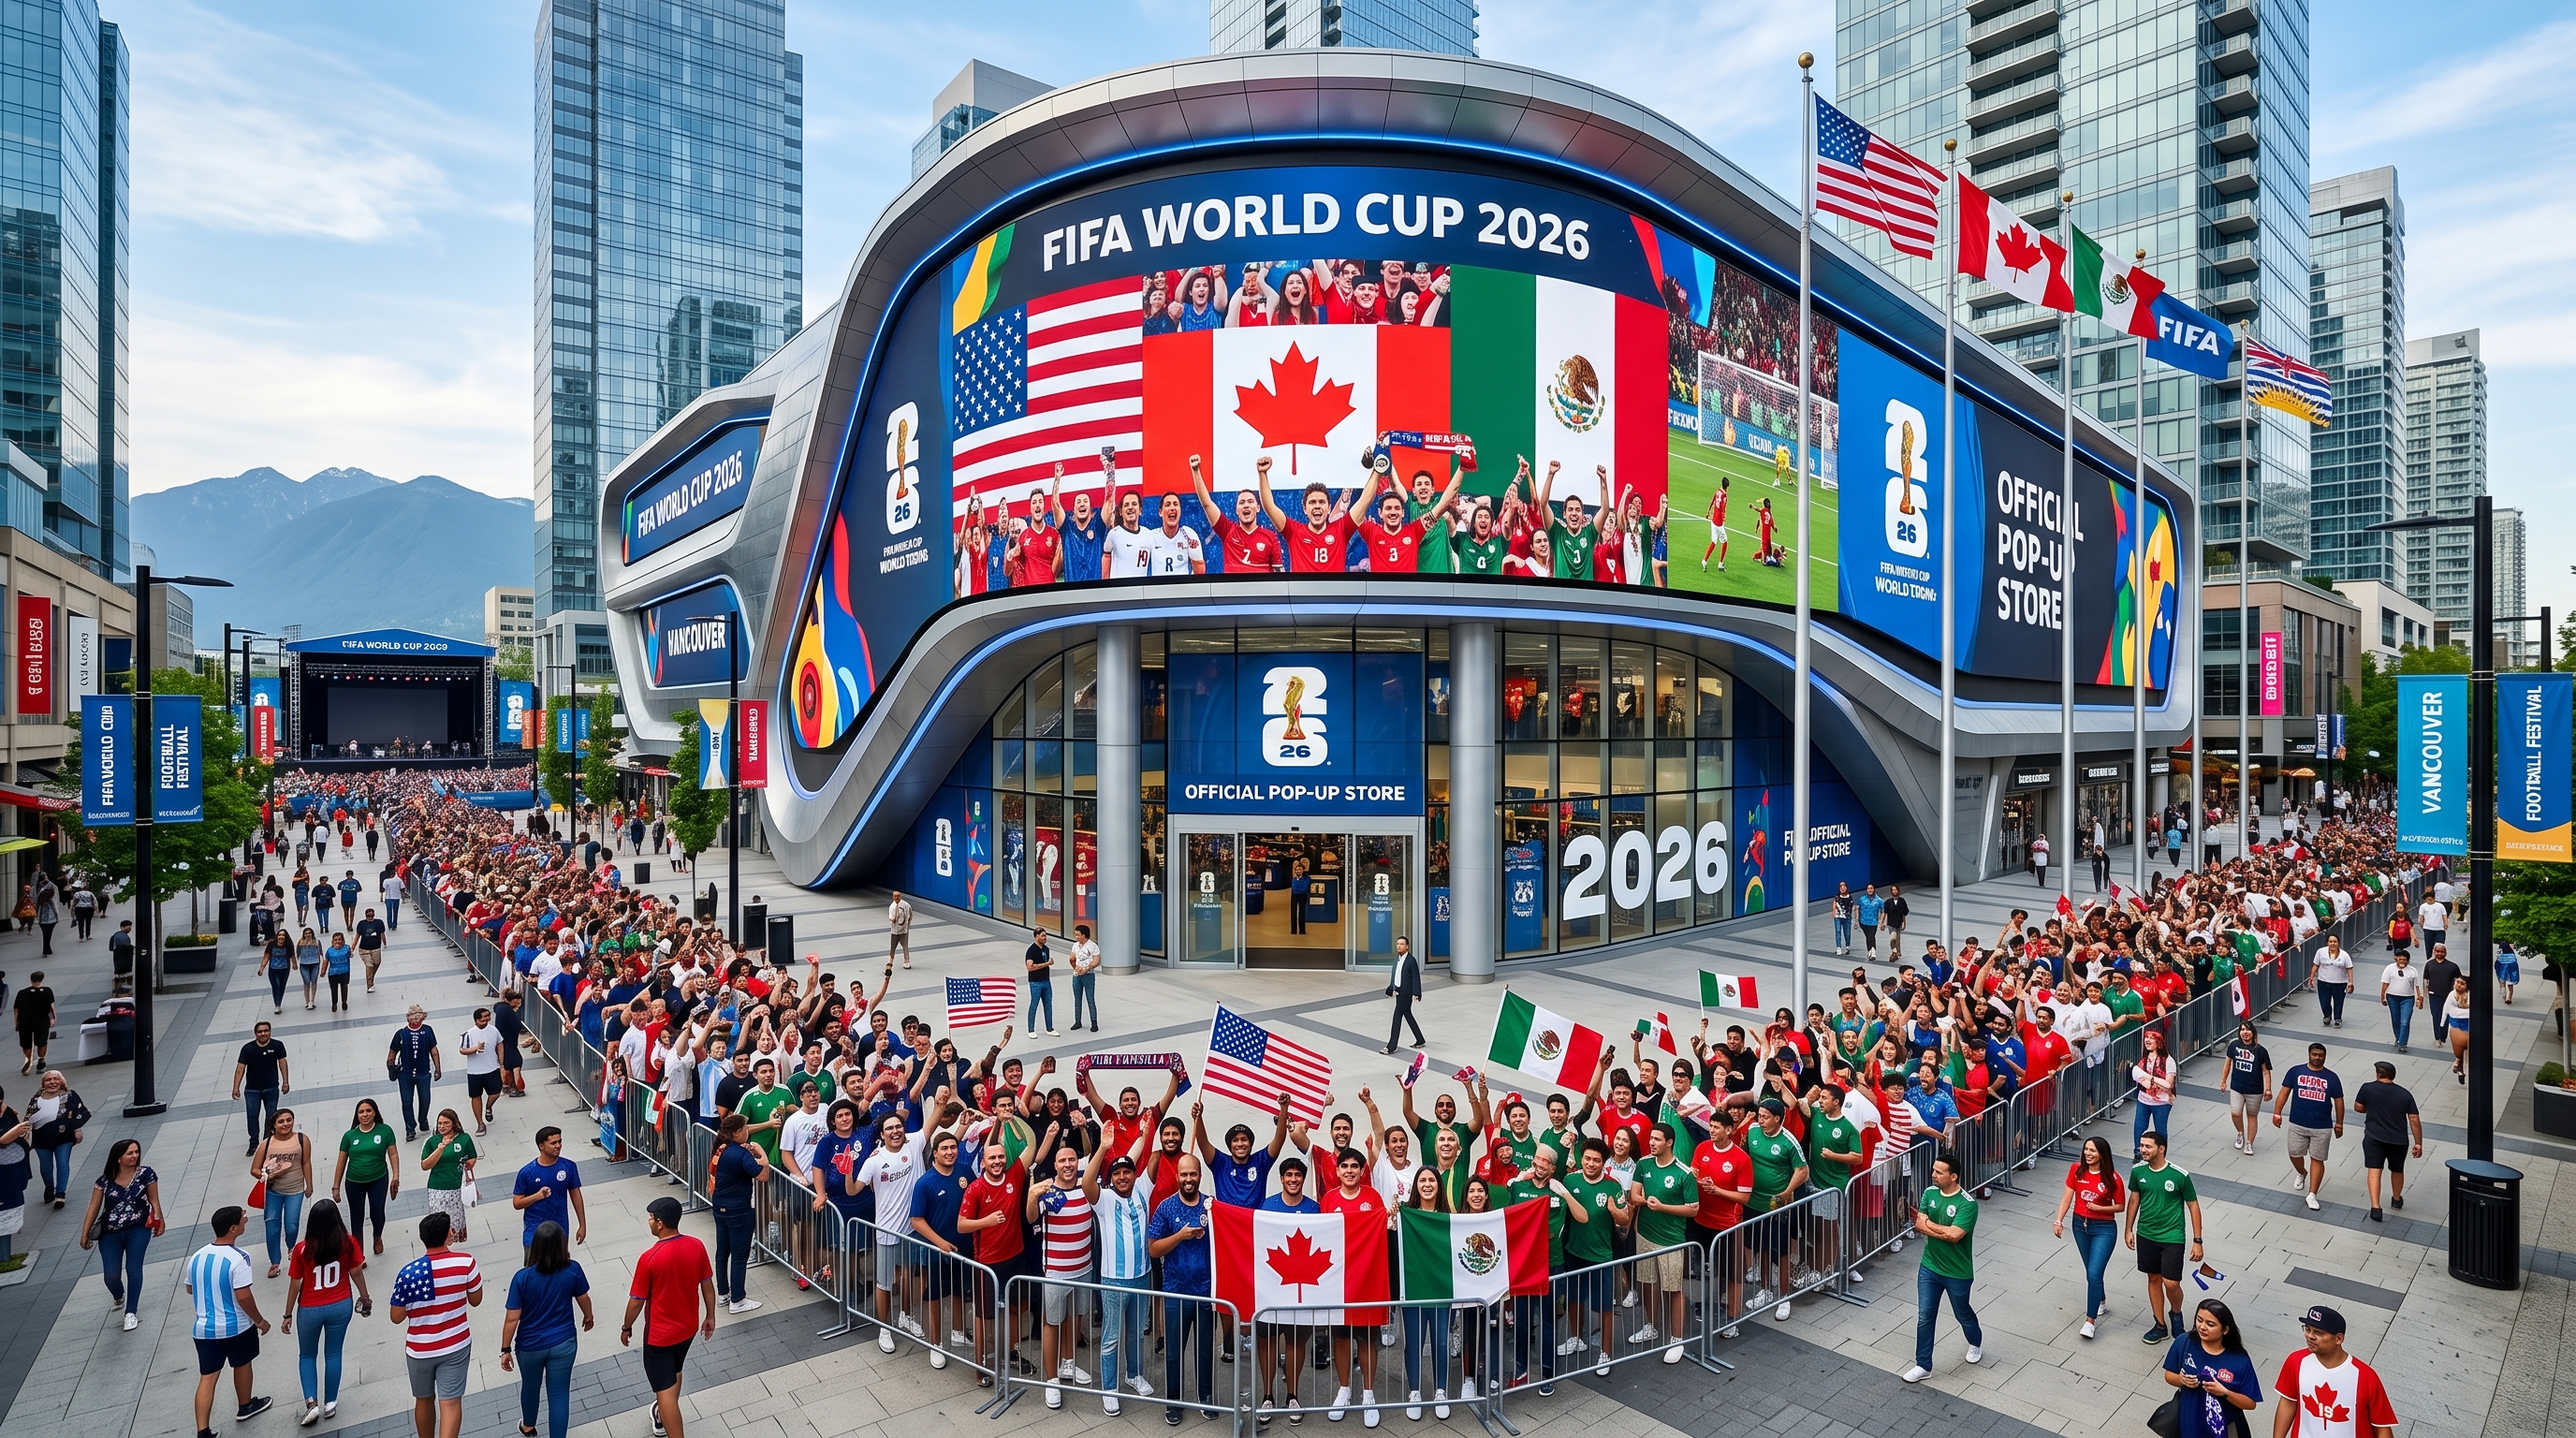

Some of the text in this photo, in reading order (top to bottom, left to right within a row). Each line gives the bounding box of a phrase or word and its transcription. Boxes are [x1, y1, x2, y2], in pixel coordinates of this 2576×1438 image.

[1044, 193, 1589, 271] FIFA WORLD CUP 2026
[2159, 315, 2218, 356] FIFA
[656, 484, 688, 527] WORLD
[691, 469, 711, 507] CUP
[714, 449, 742, 495] 2026
[1998, 471, 2084, 542] OFFICIL
[894, 503, 911, 523] 26
[1897, 521, 1916, 543] 26
[1314, 548, 1328, 563] 18
[1998, 522, 2075, 581] POP-U
[1998, 577, 2062, 630] STORE
[366, 641, 401, 650] WORLD
[667, 621, 725, 656] VANCOUVER
[2525, 685, 2542, 748] FESTIVAL
[1280, 744, 1311, 758] 26
[2422, 692, 2443, 814] VANCOUVER
[1185, 784, 1406, 801] OFFICIAL POP-UP STORE
[1822, 842, 1851, 859] STORE
[1563, 821, 1729, 921] 2026
[313, 1260, 340, 1290] 10
